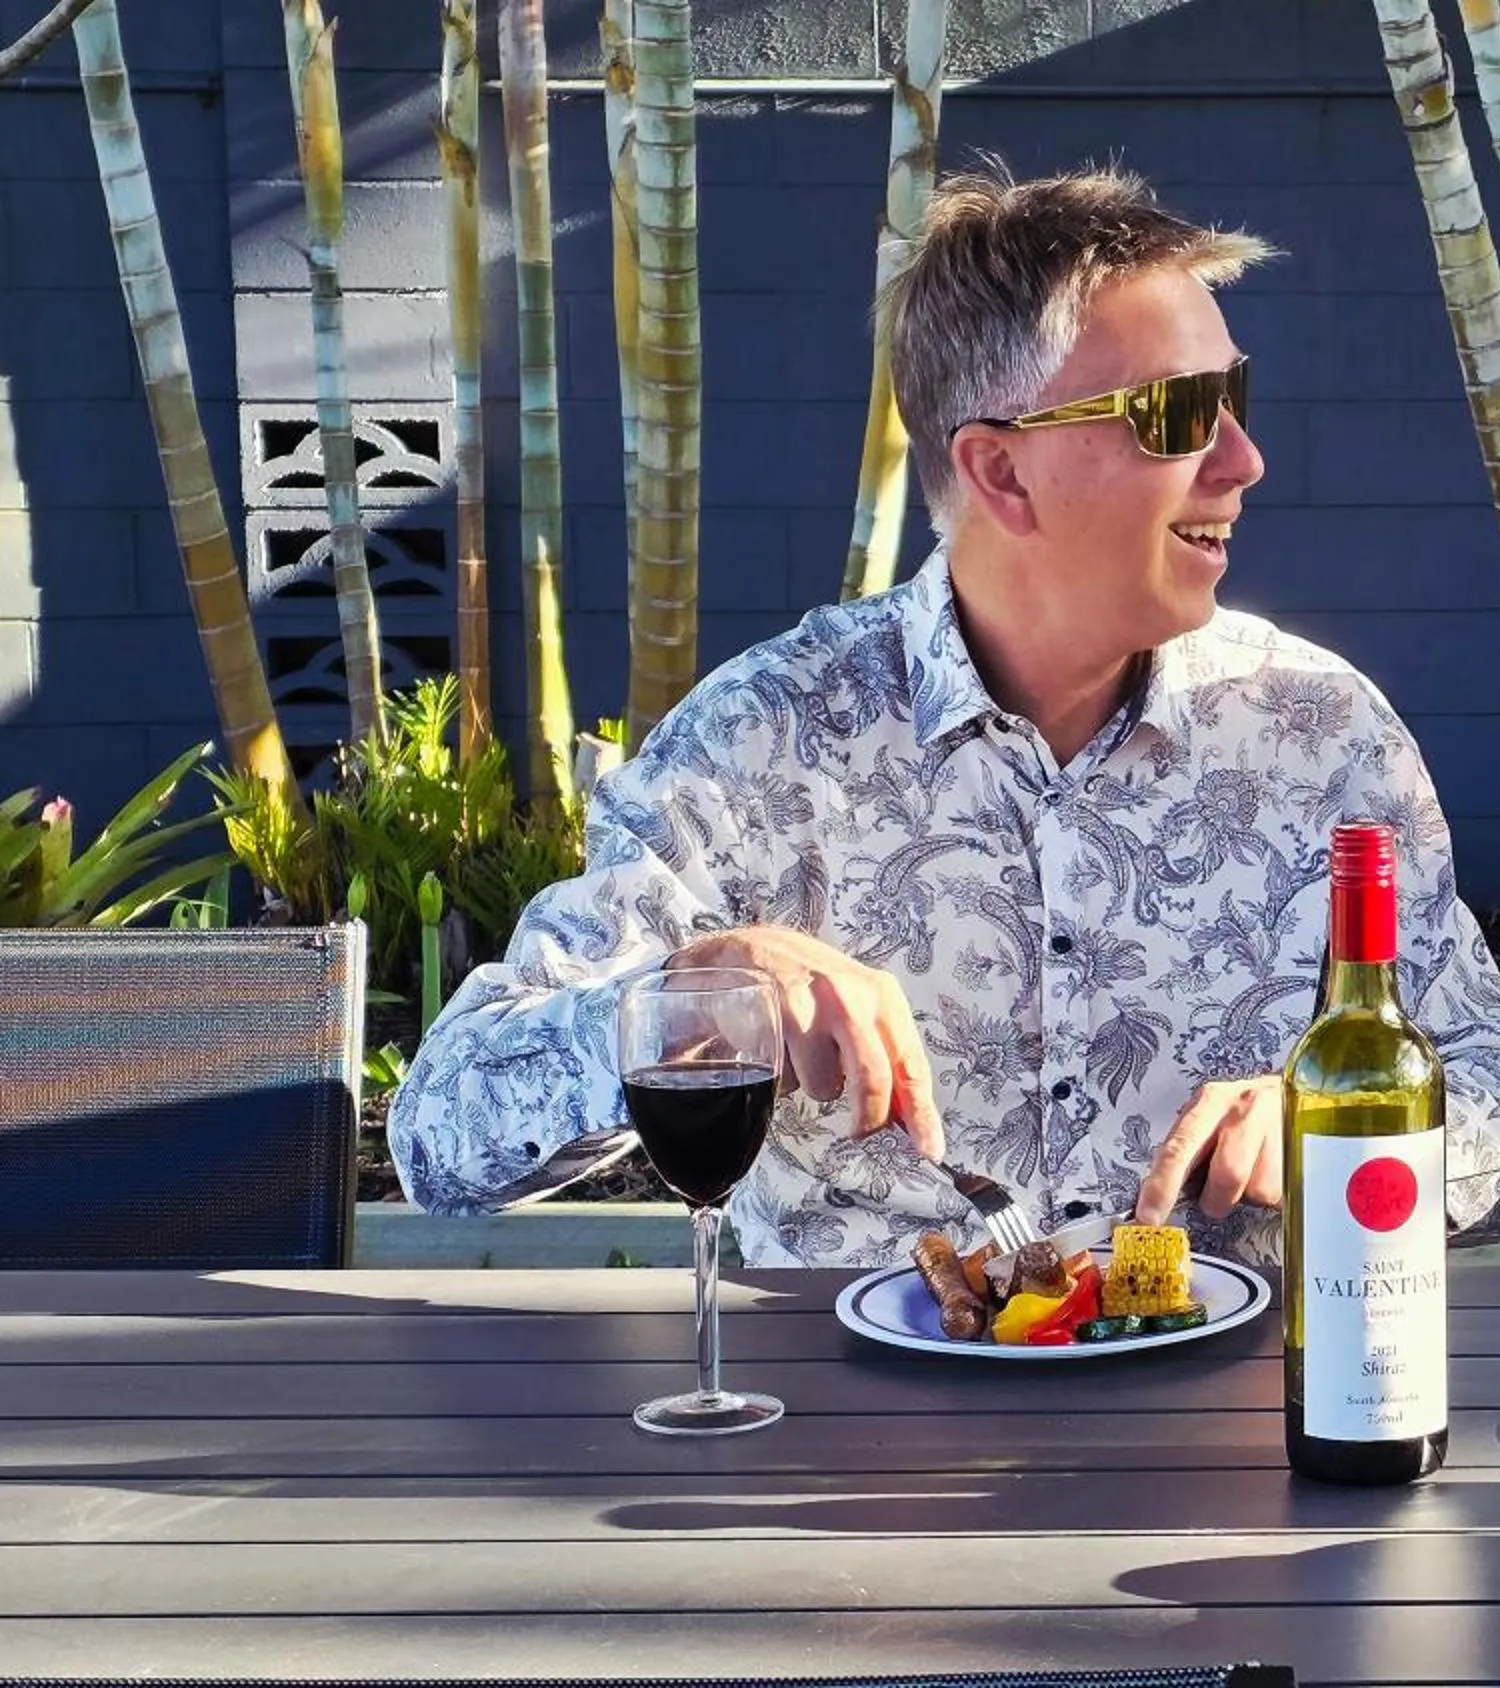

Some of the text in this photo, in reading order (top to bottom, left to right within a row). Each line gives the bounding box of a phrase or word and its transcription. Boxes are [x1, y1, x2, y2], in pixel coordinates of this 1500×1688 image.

[1362, 1259, 1404, 1275] SAINT
[1314, 1271, 1441, 1298] VALENTINE
[1361, 1360, 1406, 1377] Shiraz
